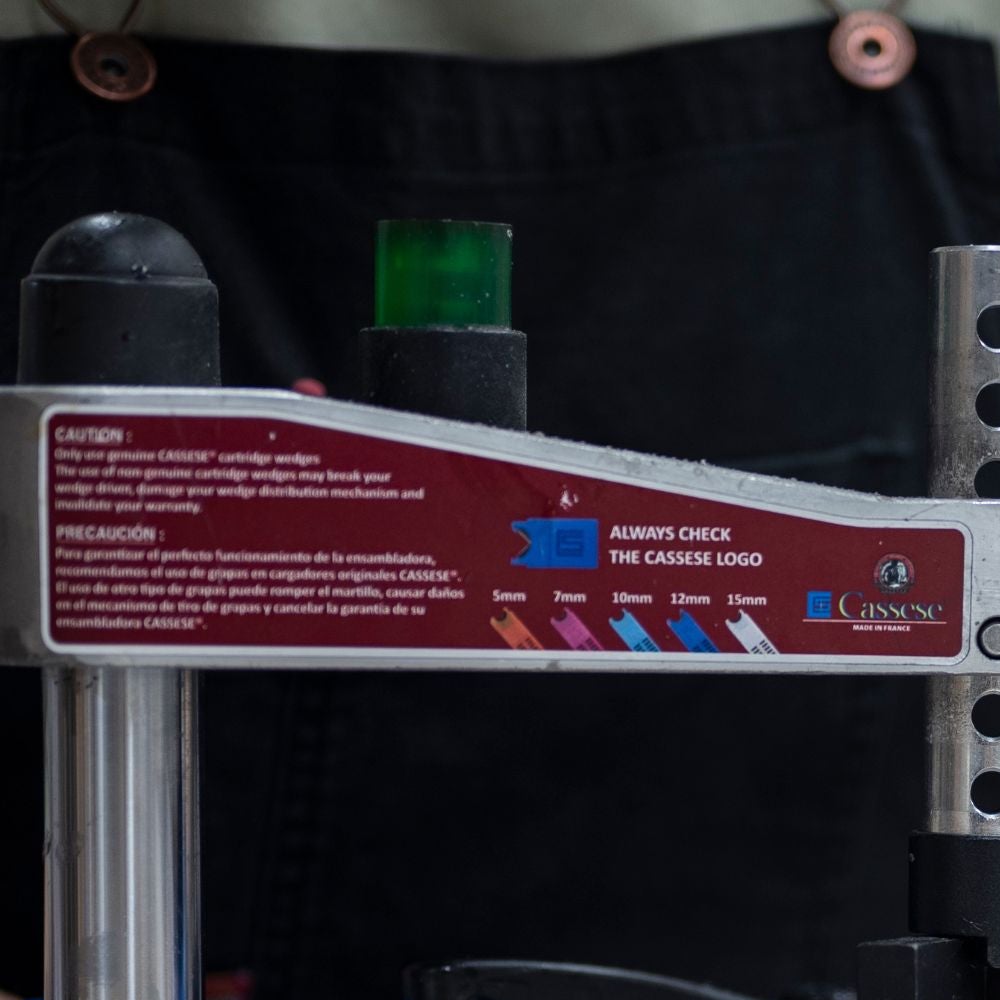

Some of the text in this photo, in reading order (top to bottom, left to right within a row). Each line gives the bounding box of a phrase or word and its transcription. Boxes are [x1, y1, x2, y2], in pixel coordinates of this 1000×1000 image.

[55, 426, 123, 442] CAUTION
[55, 522, 157, 542] PRECAUCIÓN
[609, 526, 731, 542] ALWAYS CHECK
[609, 549, 763, 567] THE CASSESE LOGO
[492, 590, 526, 602] 5mm
[553, 591, 587, 603] 7mm
[612, 592, 652, 605] 10mm
[670, 593, 710, 606] 12mm
[727, 594, 767, 607] 15mm
[839, 592, 942, 620] Cassese
[875, 624, 883, 632] IN
[884, 624, 911, 632] FRANCE
